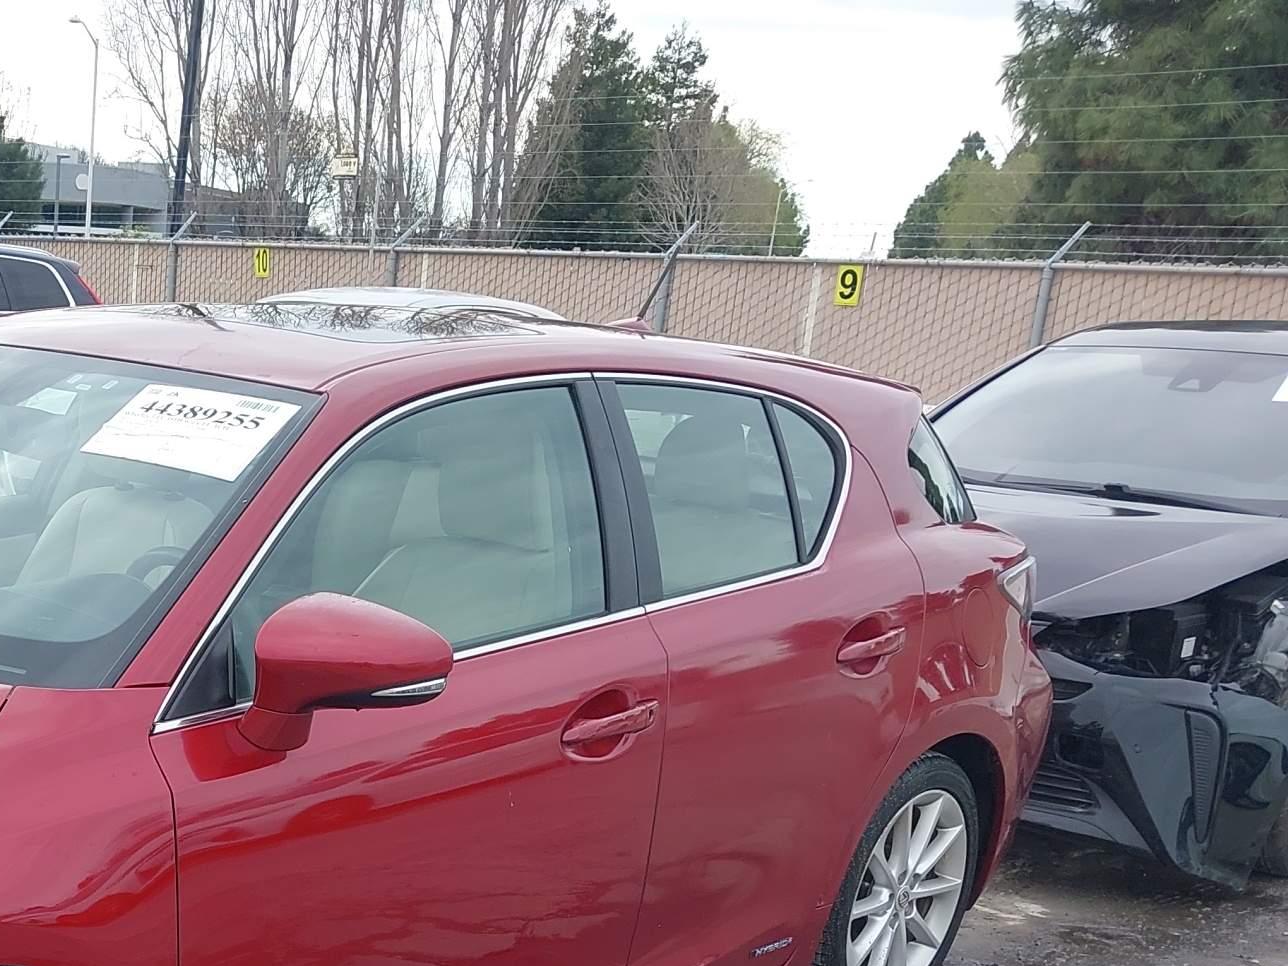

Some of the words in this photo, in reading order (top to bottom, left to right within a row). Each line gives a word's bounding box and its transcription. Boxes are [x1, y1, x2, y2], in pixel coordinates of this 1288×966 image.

[255, 249, 268, 273] 10
[839, 269, 858, 300] 9
[140, 400, 266, 430] 44389255
